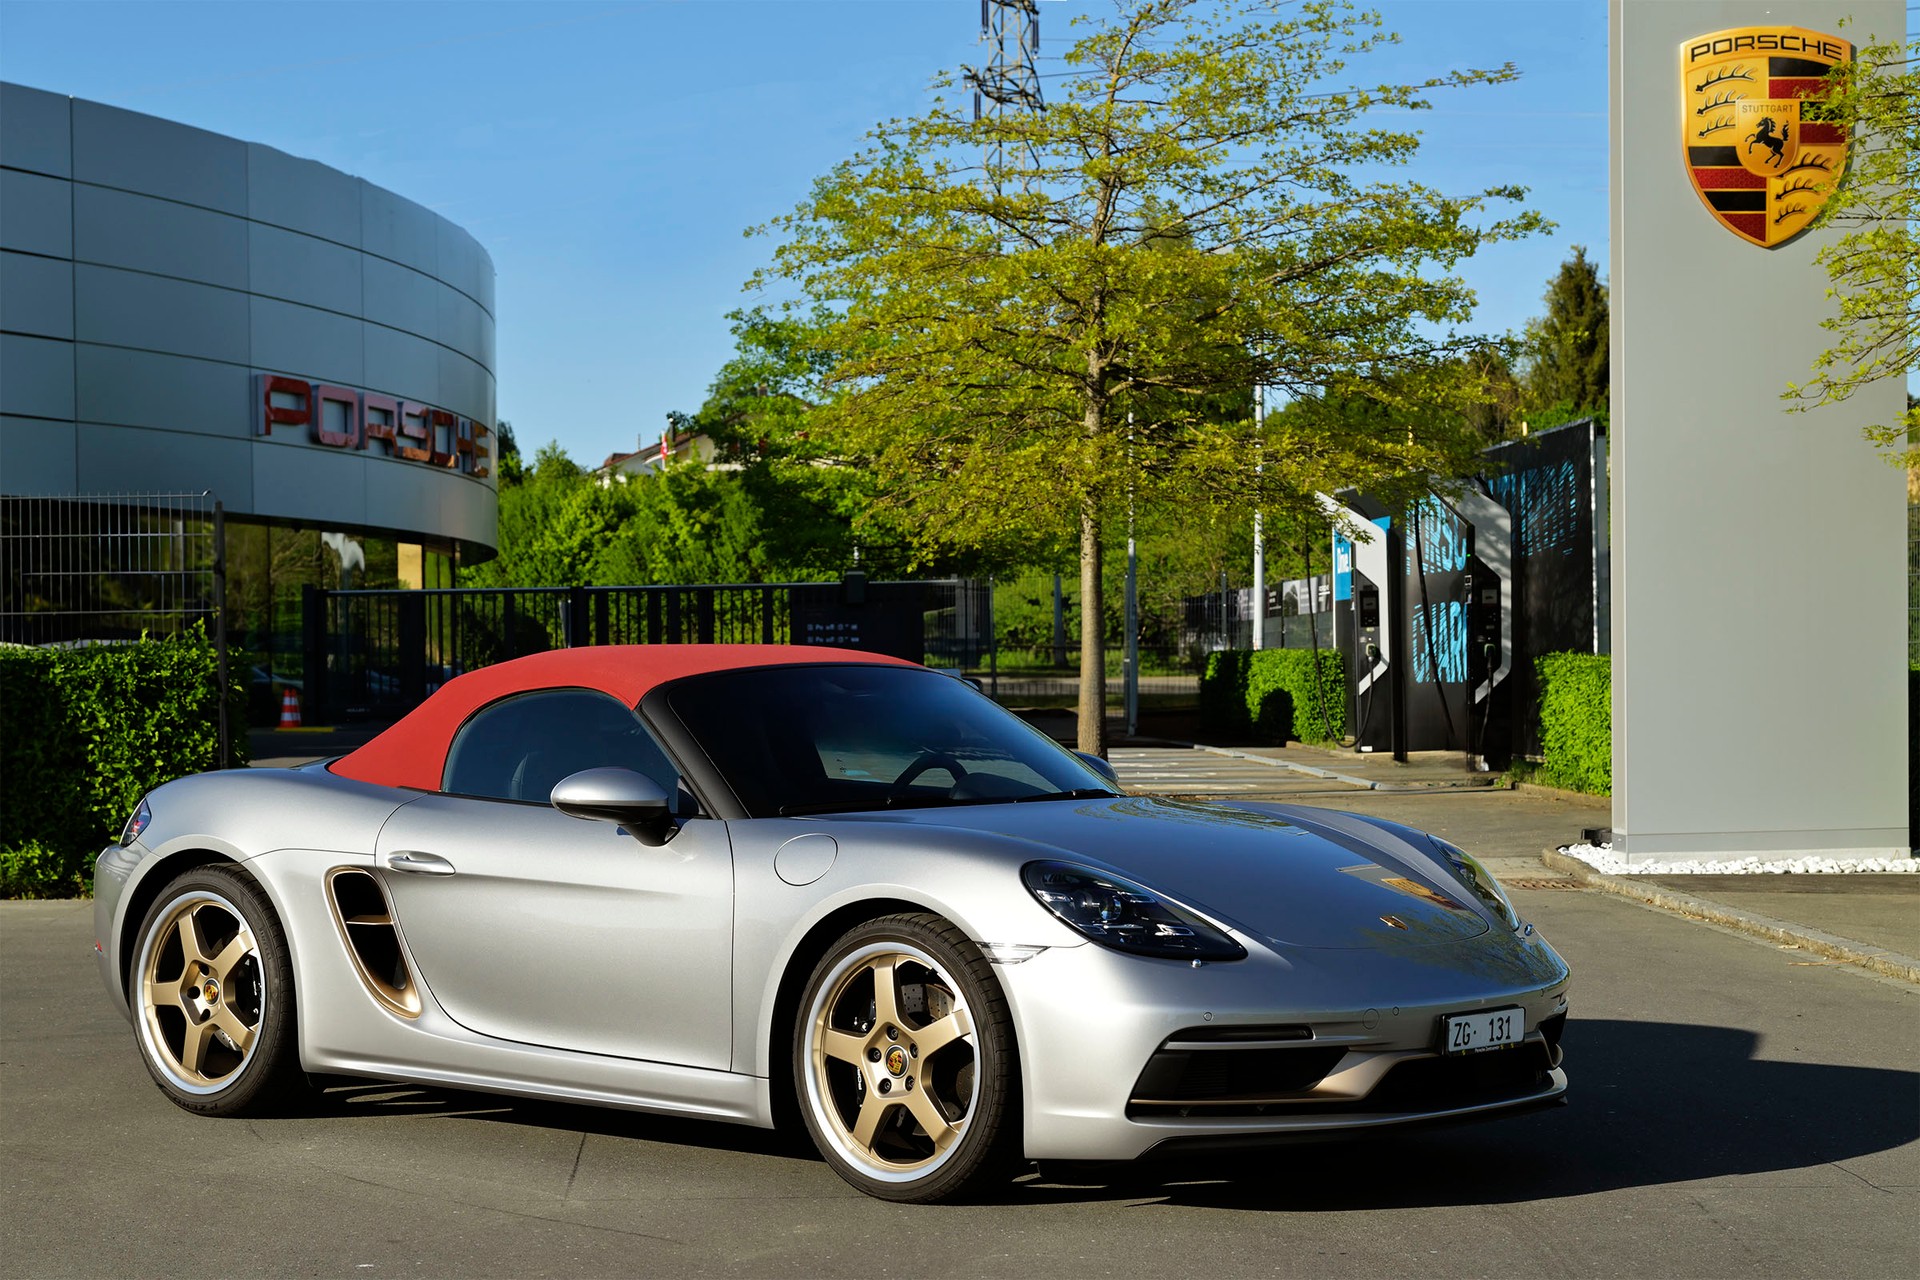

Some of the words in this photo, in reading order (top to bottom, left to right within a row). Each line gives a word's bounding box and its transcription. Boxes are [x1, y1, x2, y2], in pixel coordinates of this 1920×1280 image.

[1690, 34, 1842, 63] PORSCHE
[1741, 103, 1794, 114] STUTTGART
[256, 373, 489, 479] PORSCHE
[1488, 1015, 1511, 1042] 131
